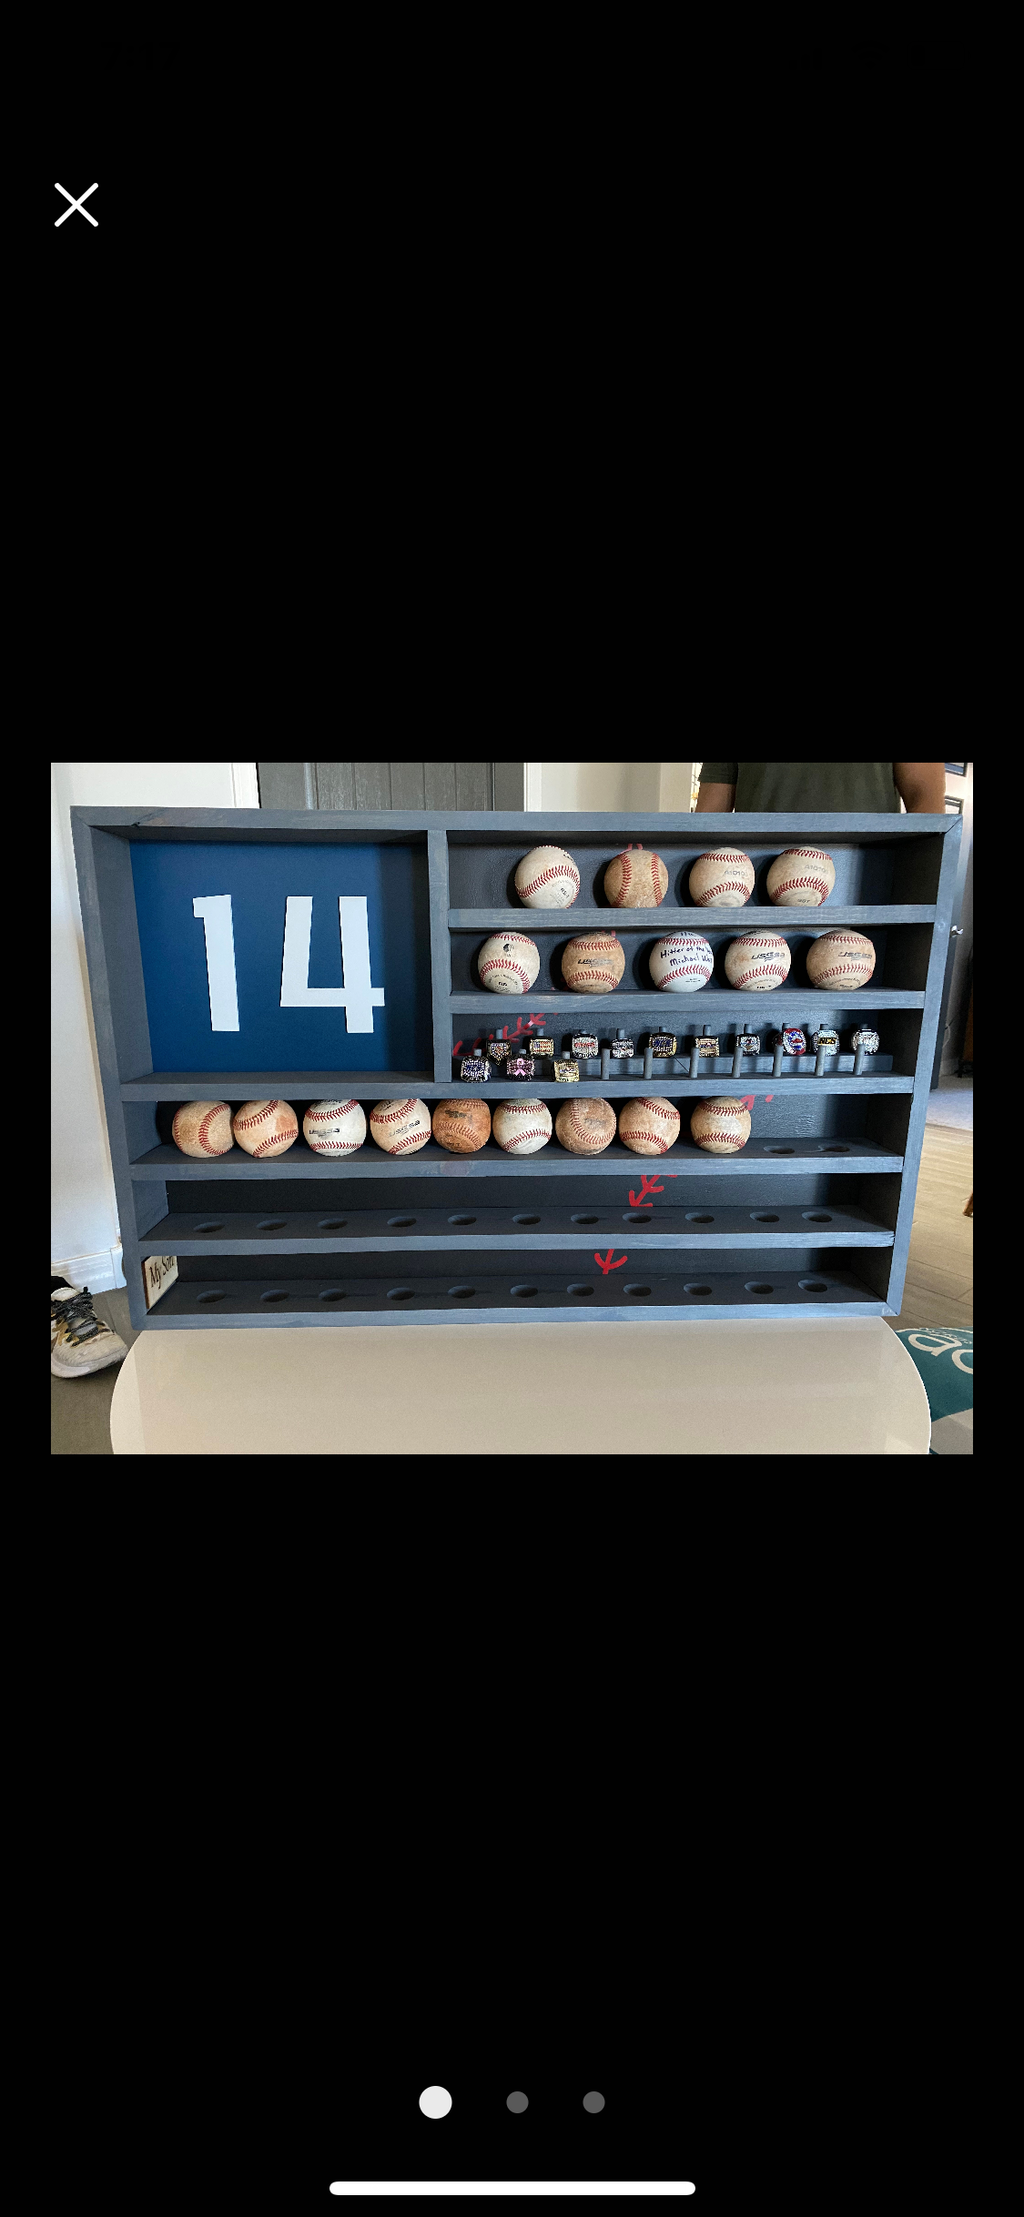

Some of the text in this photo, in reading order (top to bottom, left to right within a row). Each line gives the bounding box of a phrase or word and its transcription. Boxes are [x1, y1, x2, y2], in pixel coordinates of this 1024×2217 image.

[660, 947, 684, 959] Hitter
[669, 953, 700, 966] Michael
[193, 895, 385, 1033] 14
[149, 1262, 162, 1290] My
